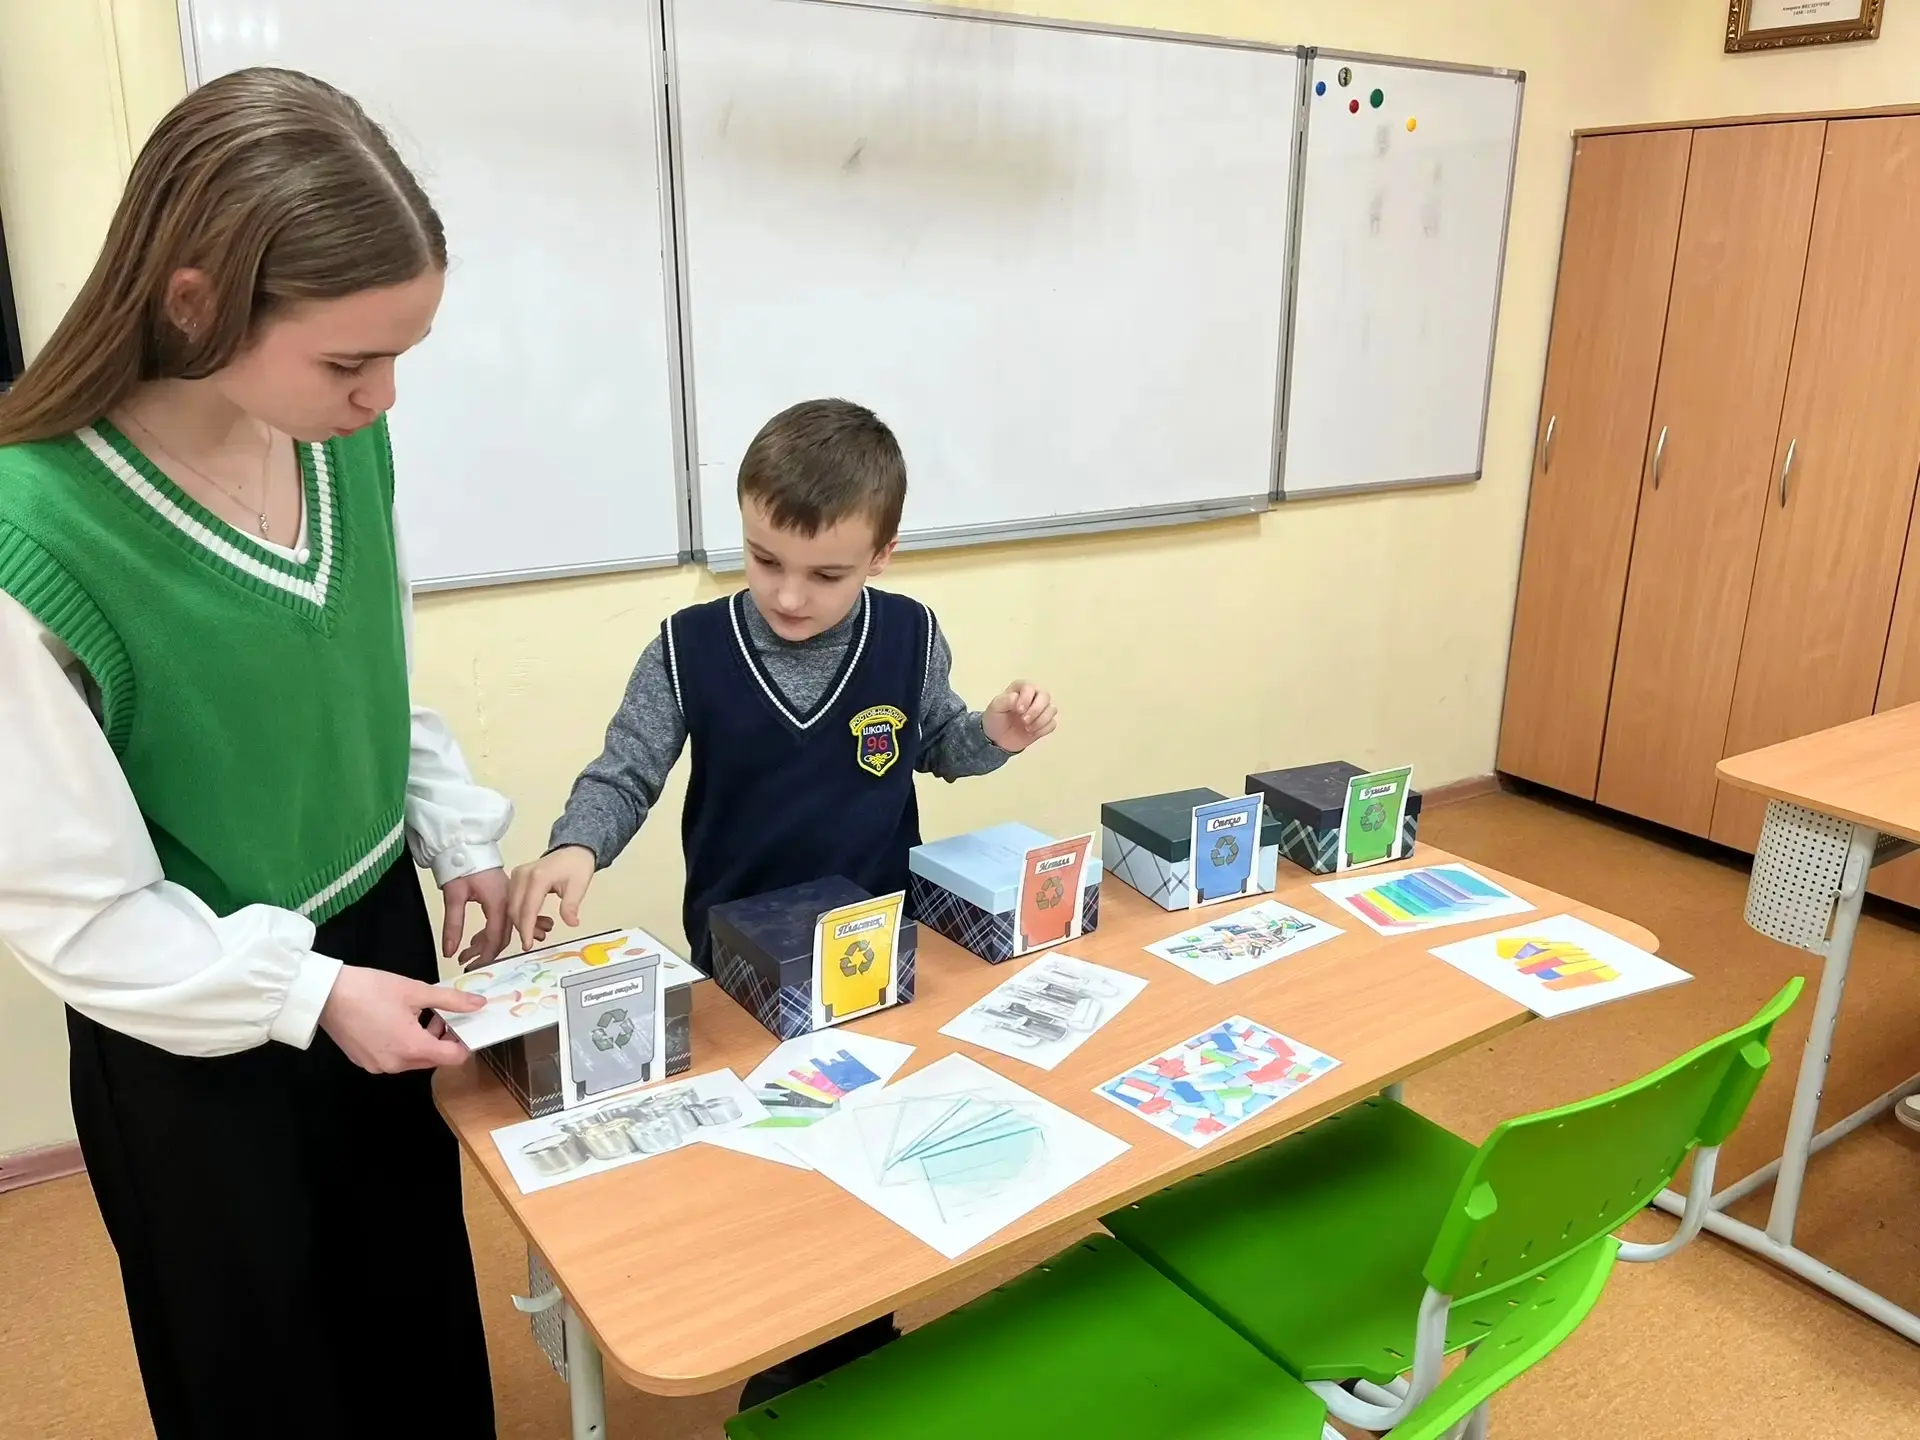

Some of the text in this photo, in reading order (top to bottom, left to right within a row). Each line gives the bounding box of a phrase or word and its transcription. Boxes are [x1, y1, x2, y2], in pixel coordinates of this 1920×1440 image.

[863, 724, 891, 735] ШКОЛА
[867, 735, 888, 752] 96
[1213, 816, 1242, 829] Стекло
[1039, 857, 1070, 872] Металл
